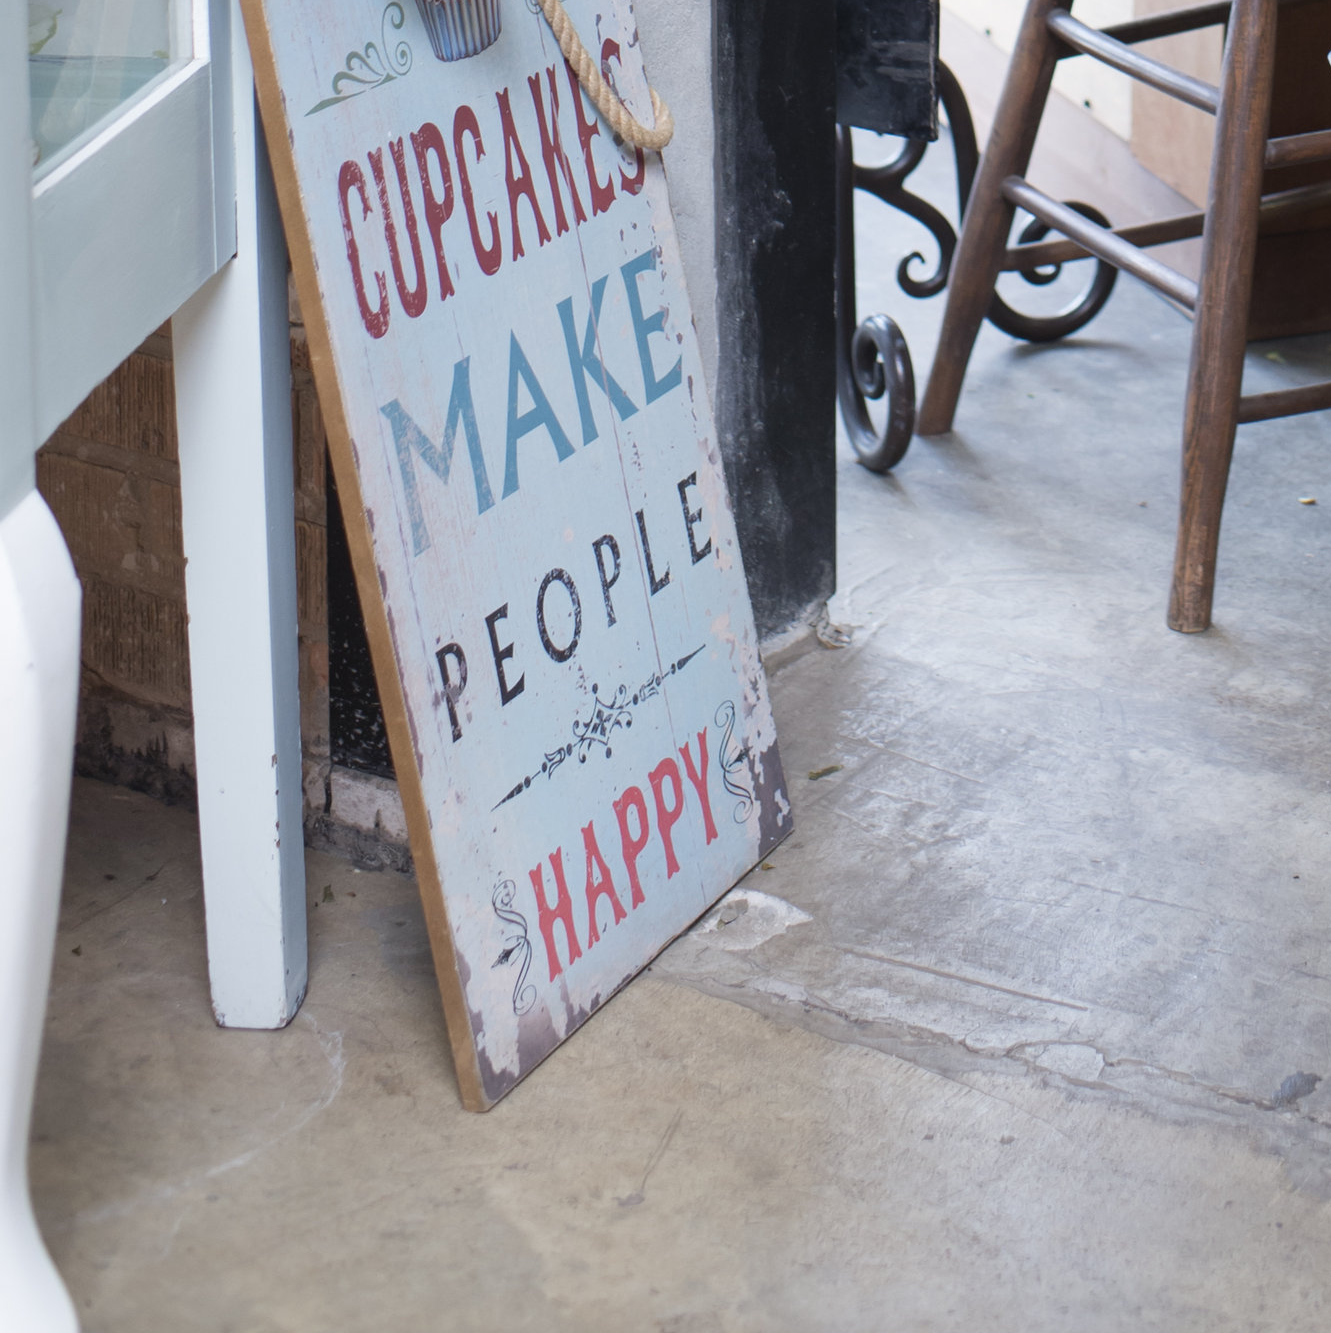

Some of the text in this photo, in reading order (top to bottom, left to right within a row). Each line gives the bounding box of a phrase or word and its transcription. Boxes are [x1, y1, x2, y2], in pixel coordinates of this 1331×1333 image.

[337, 37, 646, 339] CUPCAKES
[380, 247, 683, 557] MAKE
[435, 470, 713, 743] PEOPLE
[528, 726, 719, 983] HAPPY
